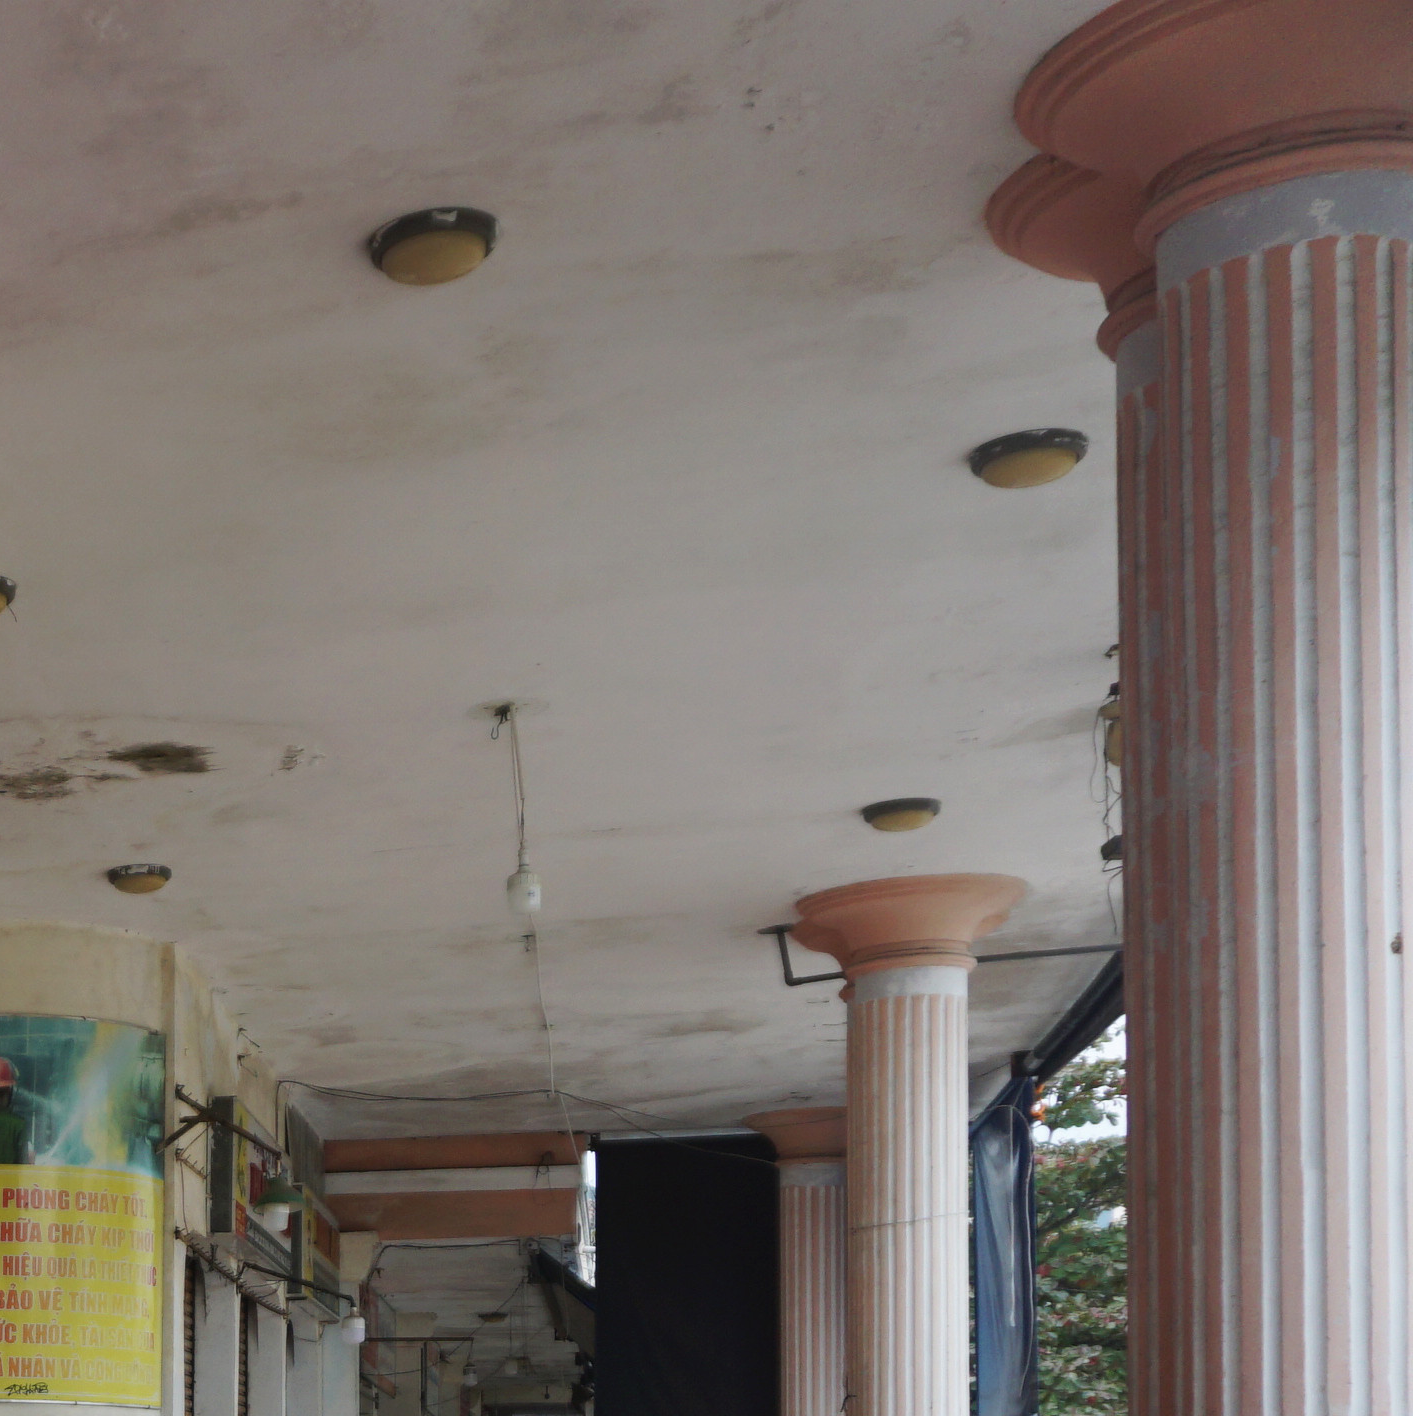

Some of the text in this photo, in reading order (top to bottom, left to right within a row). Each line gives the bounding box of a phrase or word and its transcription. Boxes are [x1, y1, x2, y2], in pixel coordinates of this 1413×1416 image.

[1, 1184, 70, 1211] PHÒNG
[74, 1188, 119, 1214] CHÁY
[47, 1220, 97, 1246] CHÁY
[2, 1251, 42, 1280] HIỆU
[46, 1252, 78, 1279] QUẢ
[37, 1286, 63, 1315] VỆ
[8, 1354, 58, 1379] NHÂN
[60, 1353, 81, 1379] VÀ
